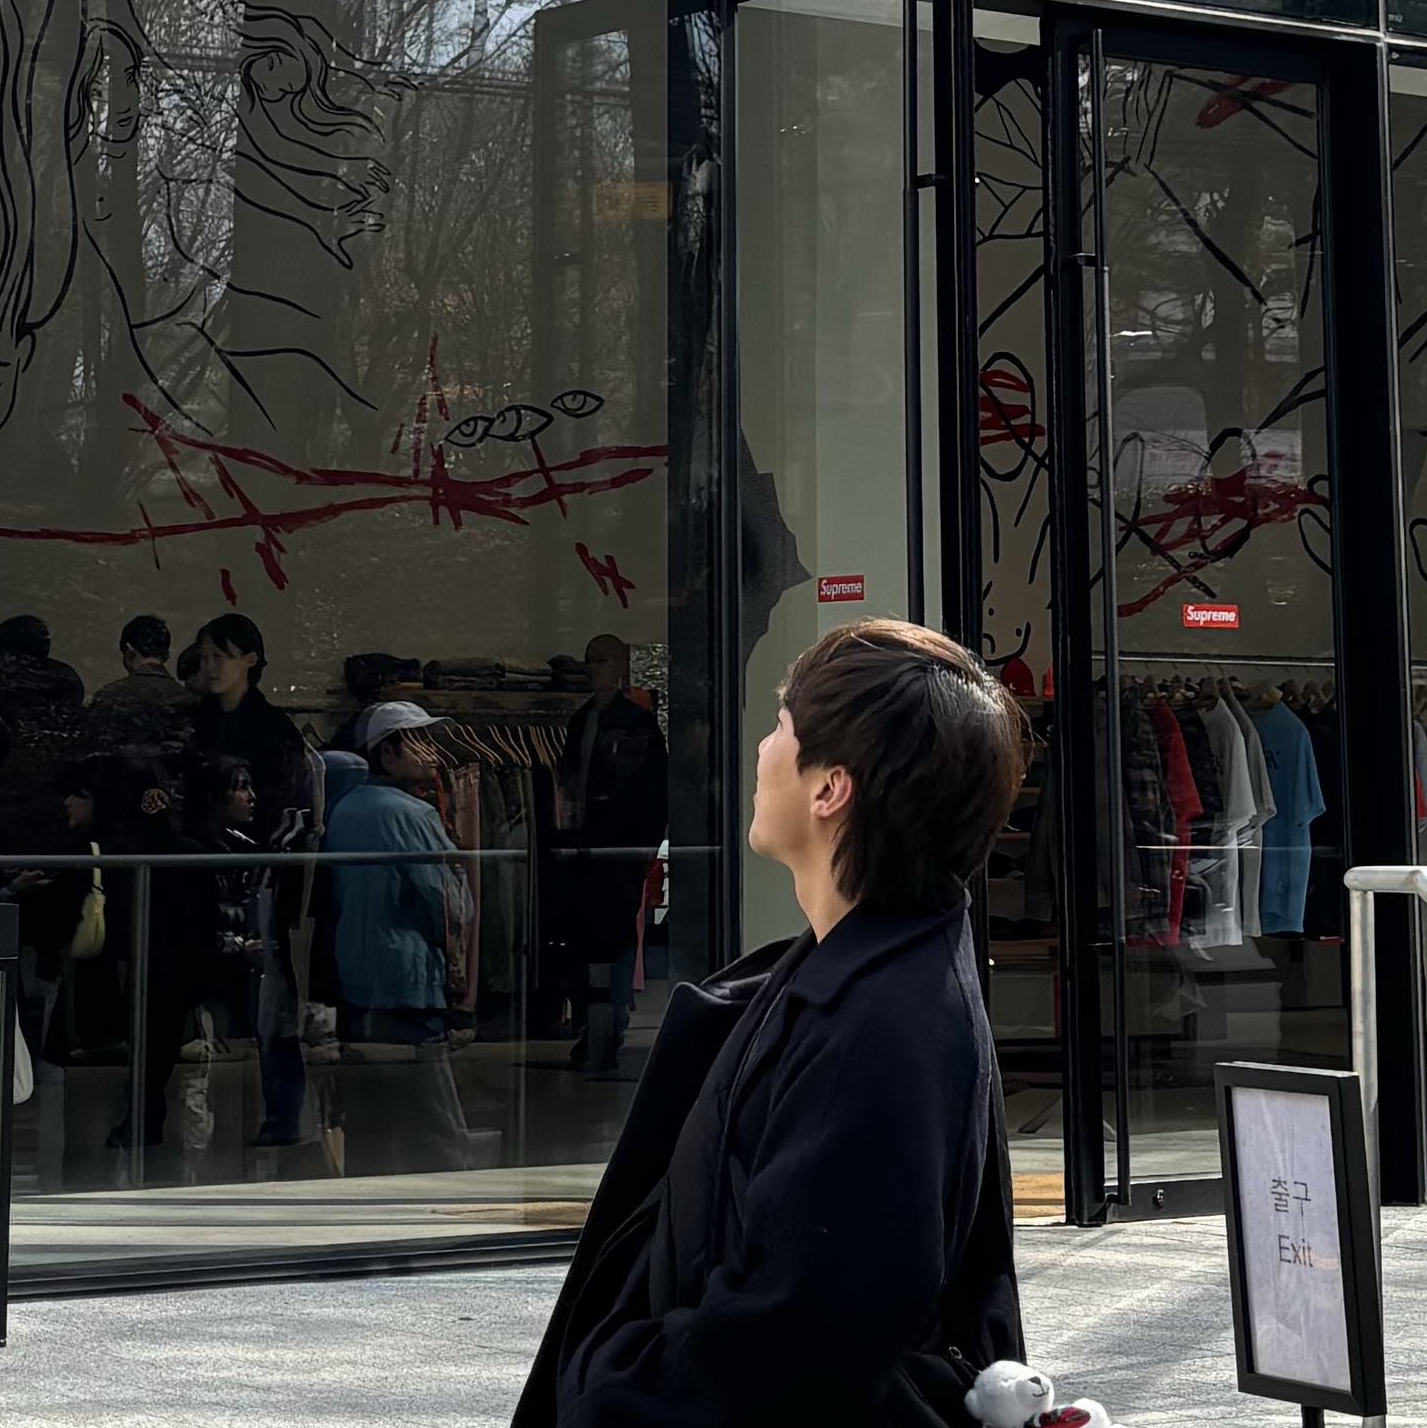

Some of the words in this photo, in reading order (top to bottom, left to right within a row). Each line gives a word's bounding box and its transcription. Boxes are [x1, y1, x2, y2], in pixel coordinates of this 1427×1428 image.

[820, 579, 863, 600] Supreme
[1186, 605, 1237, 626] Supreme
[1271, 1178, 1312, 1216] 출구
[1278, 1233, 1315, 1269] Exit
